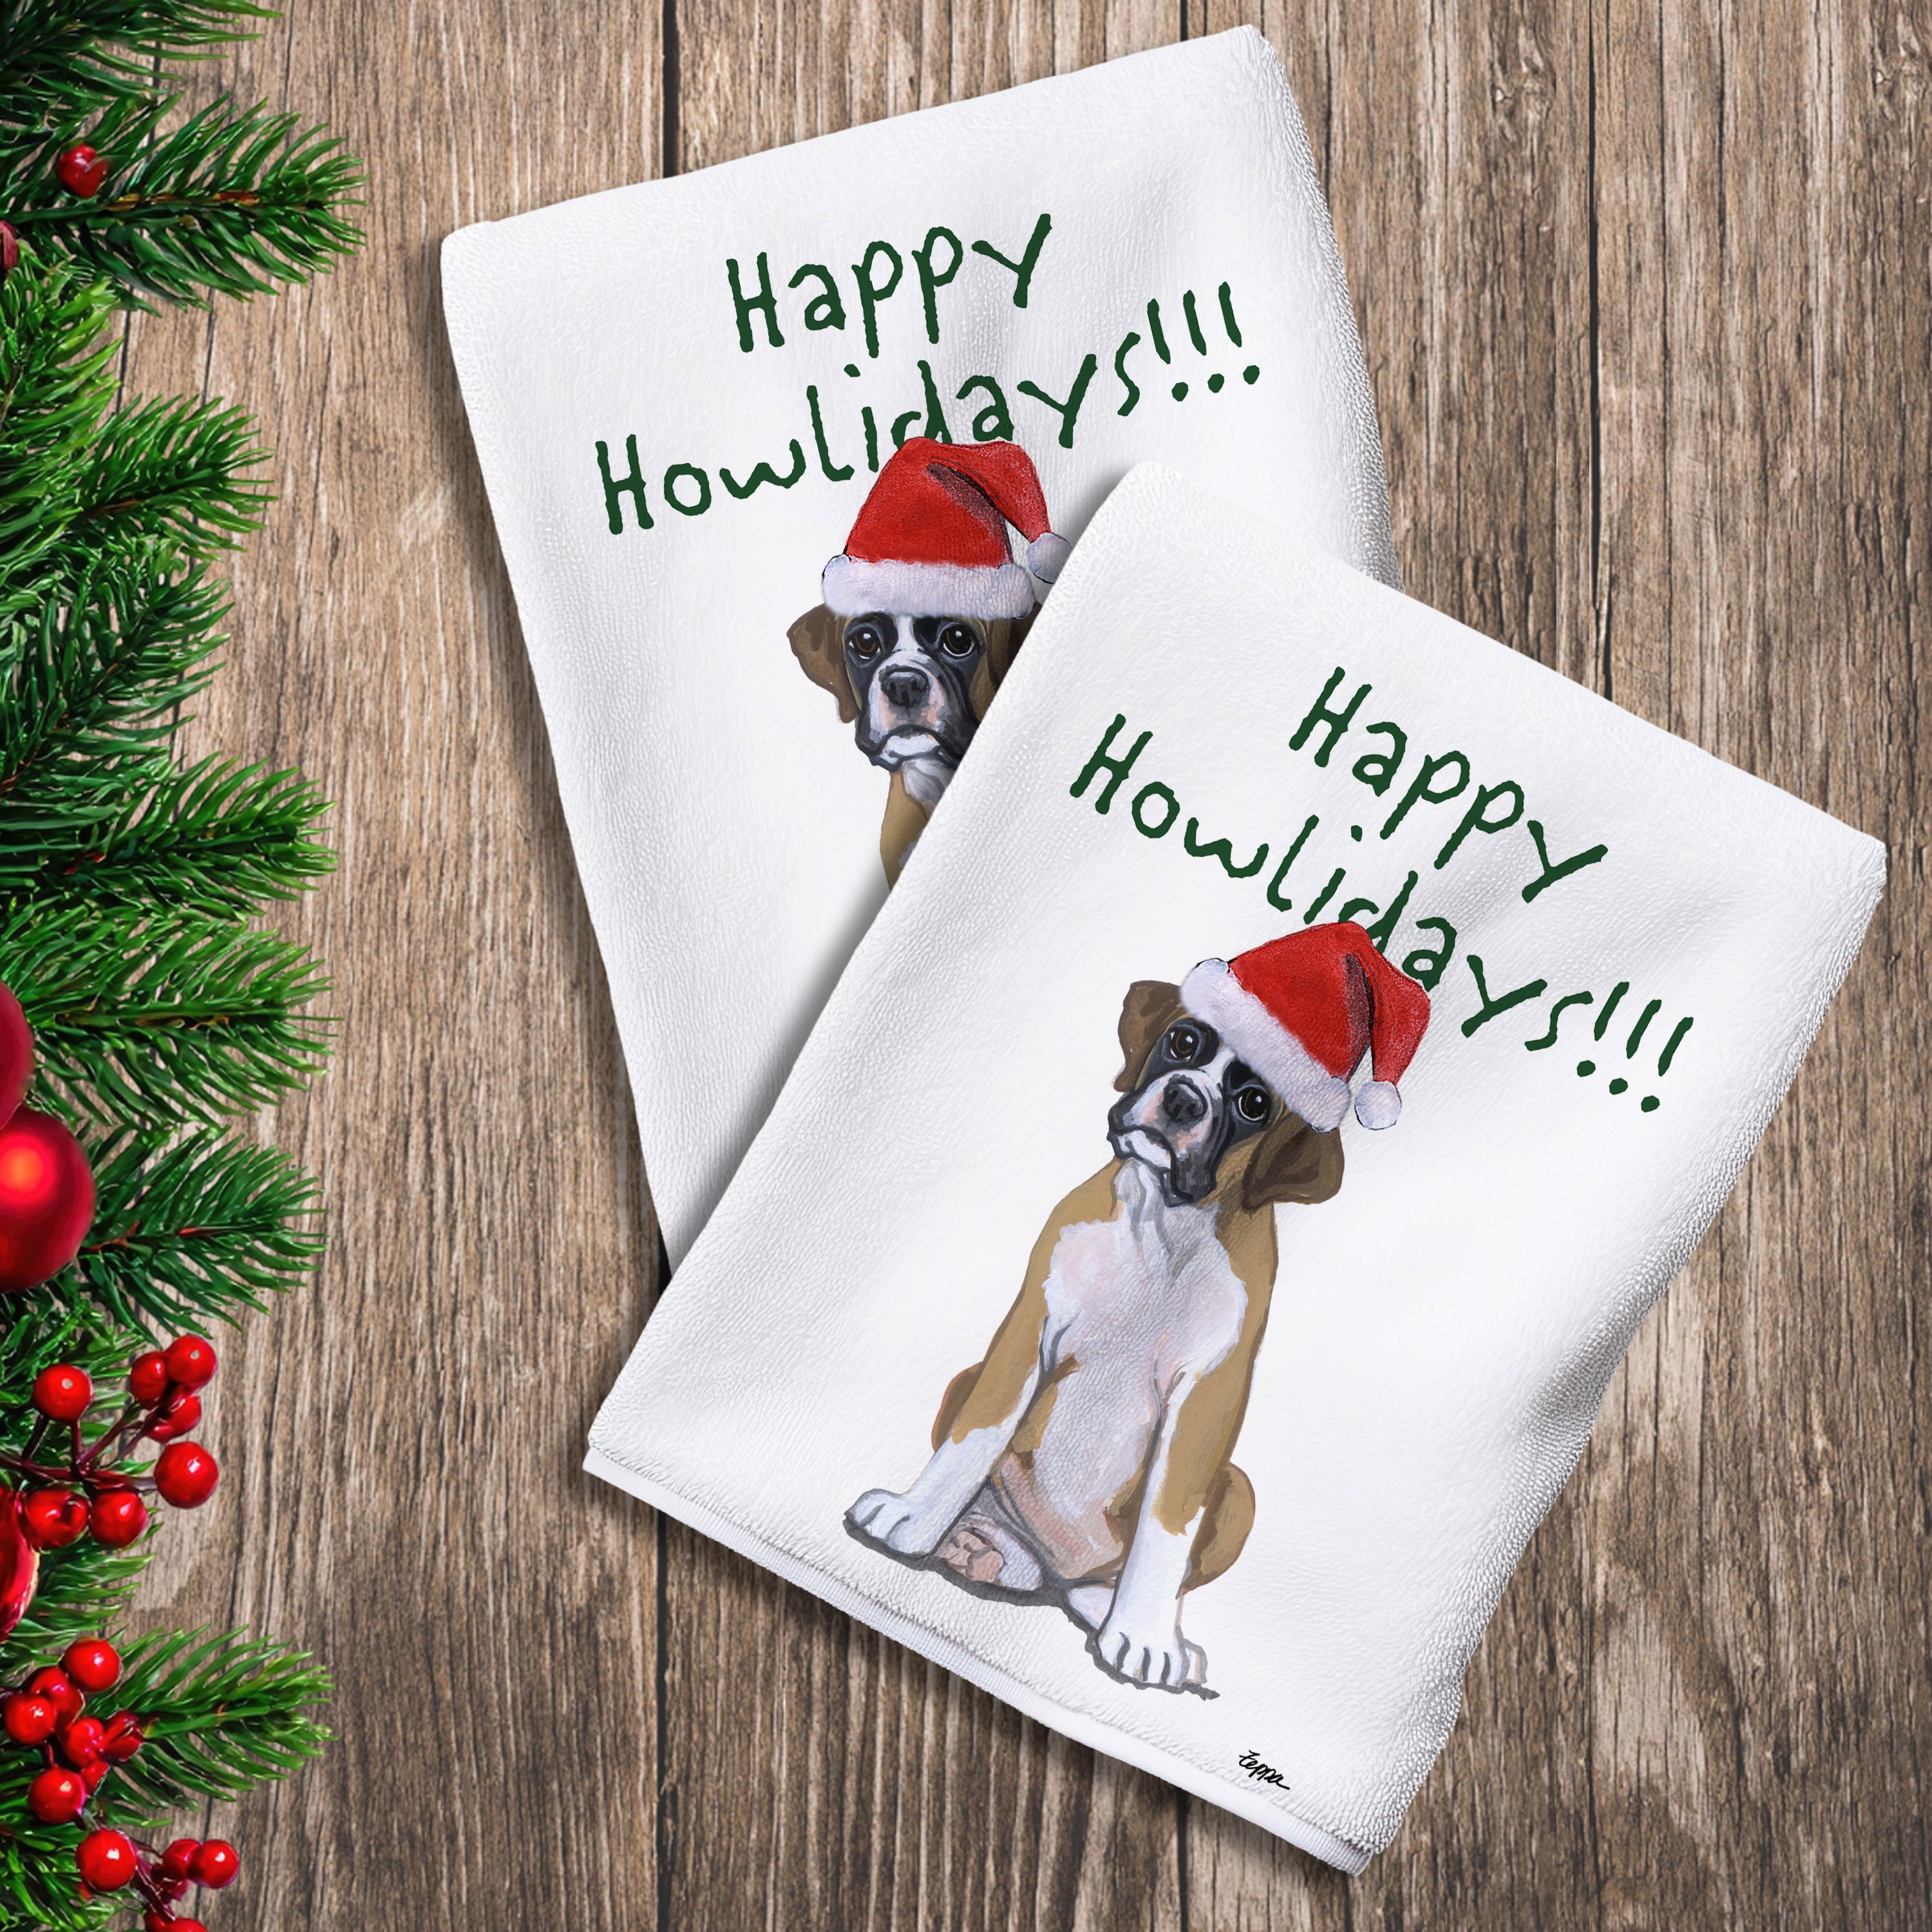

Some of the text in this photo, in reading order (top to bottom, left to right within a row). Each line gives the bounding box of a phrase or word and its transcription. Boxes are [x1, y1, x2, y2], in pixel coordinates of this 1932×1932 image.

[594, 281, 1260, 535] Howlidays!!!
[725, 213, 1052, 359] Happy
[1289, 666, 1608, 904] Happy
[1069, 713, 1694, 1113] Howlidays!!!
